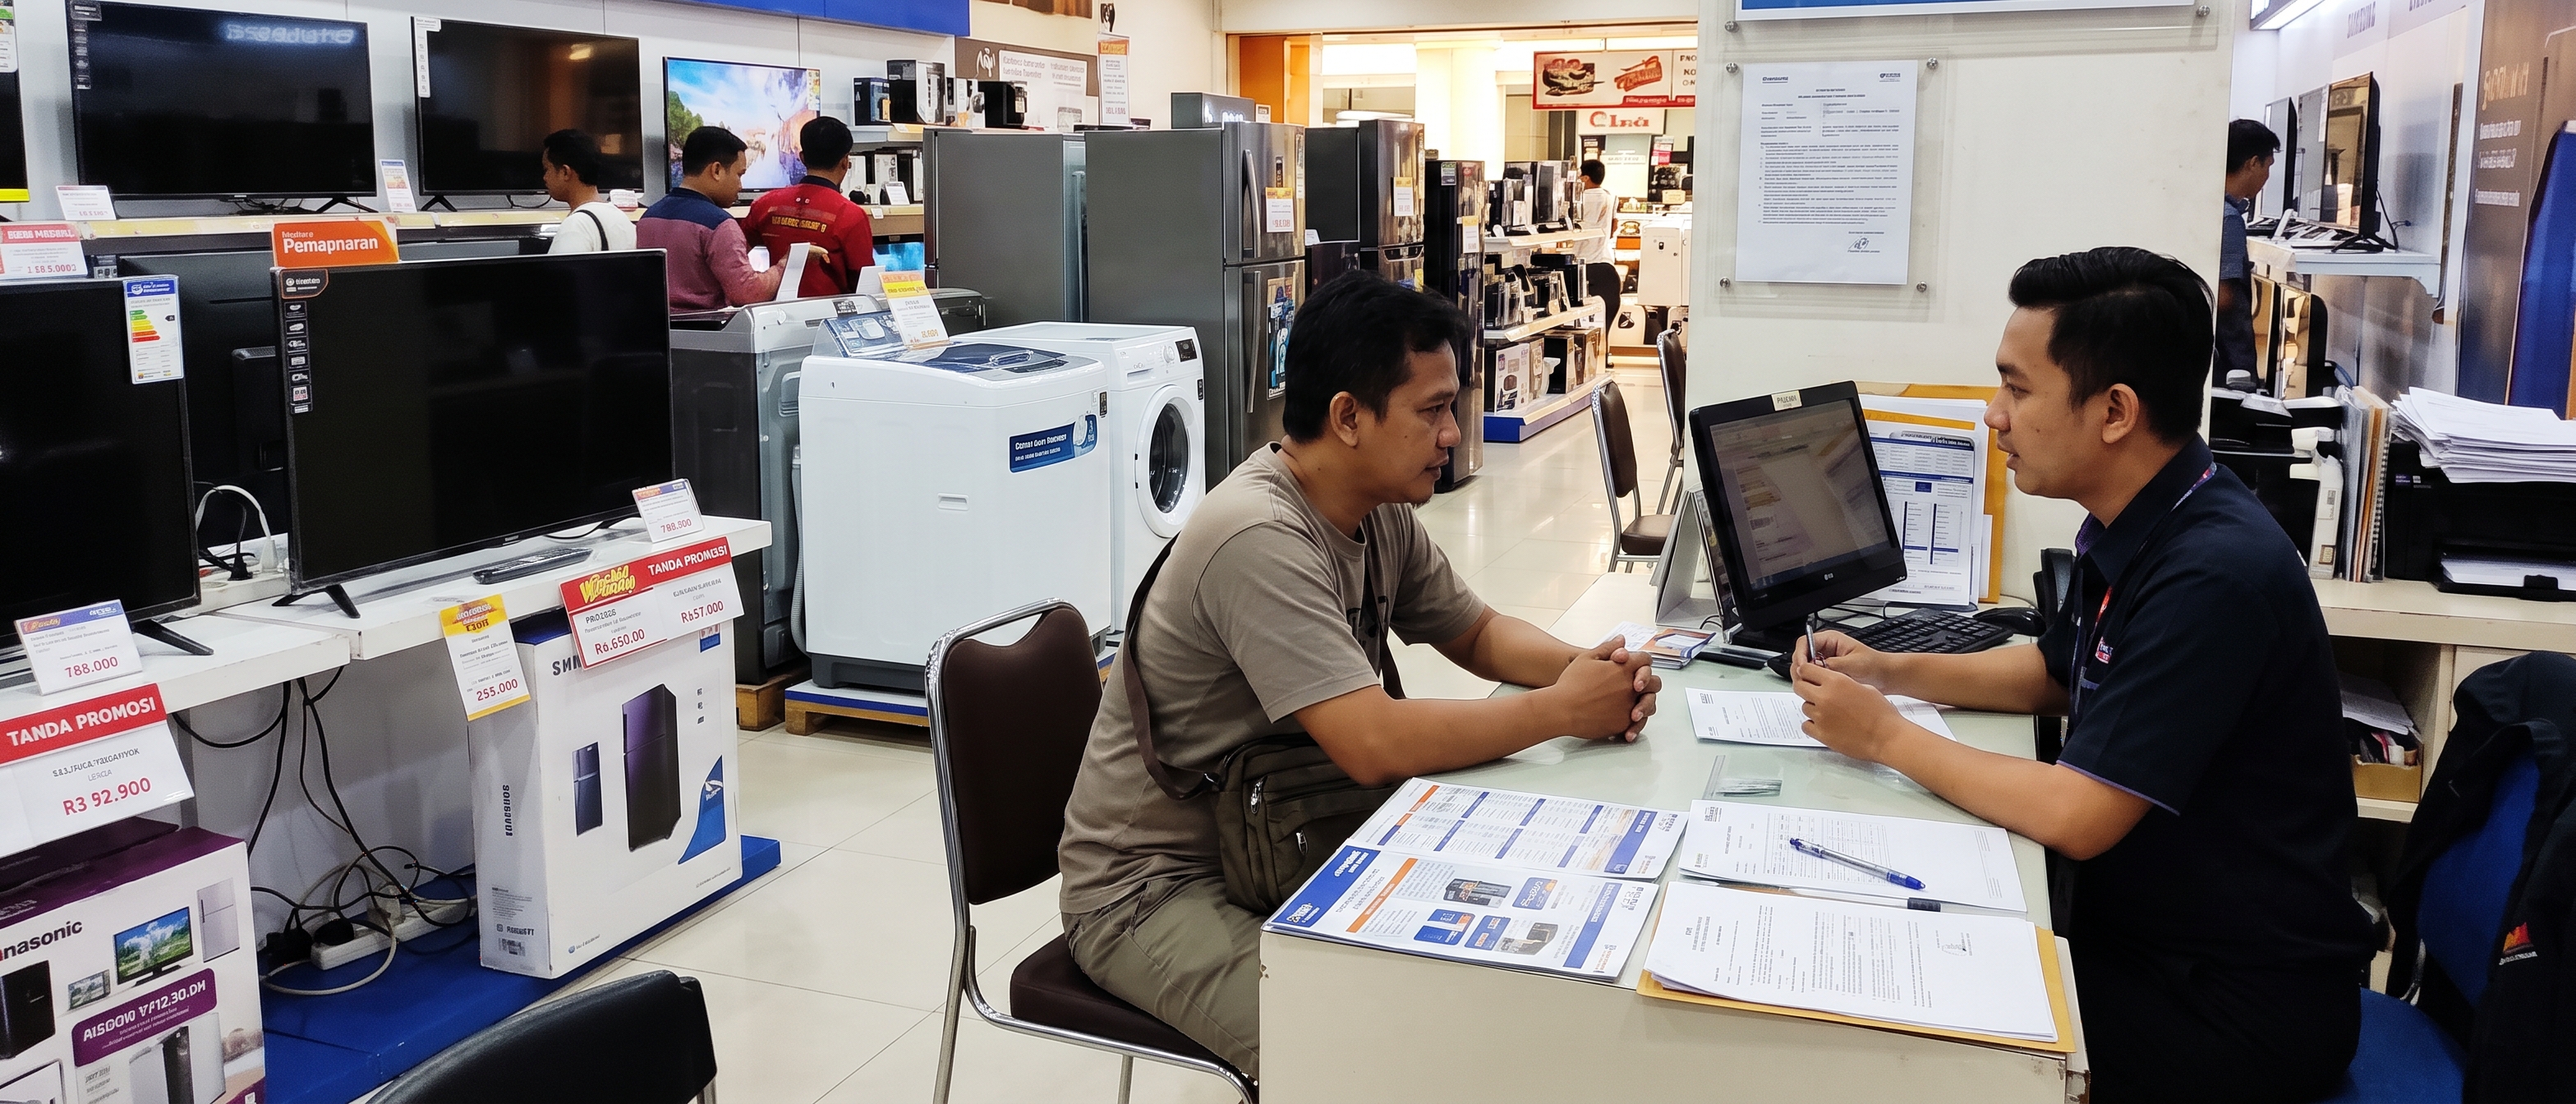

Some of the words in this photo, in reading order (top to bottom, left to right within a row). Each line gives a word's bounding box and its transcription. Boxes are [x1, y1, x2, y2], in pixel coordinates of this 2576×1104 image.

[283, 237, 379, 255] Pemapnaran
[647, 559, 683, 576] TANDA
[64, 656, 119, 678] 788.000
[476, 678, 519, 702] 255.000
[6, 719, 73, 747] TANDA
[76, 697, 157, 730] PROMOSI
[0, 920, 83, 962] nasonic
